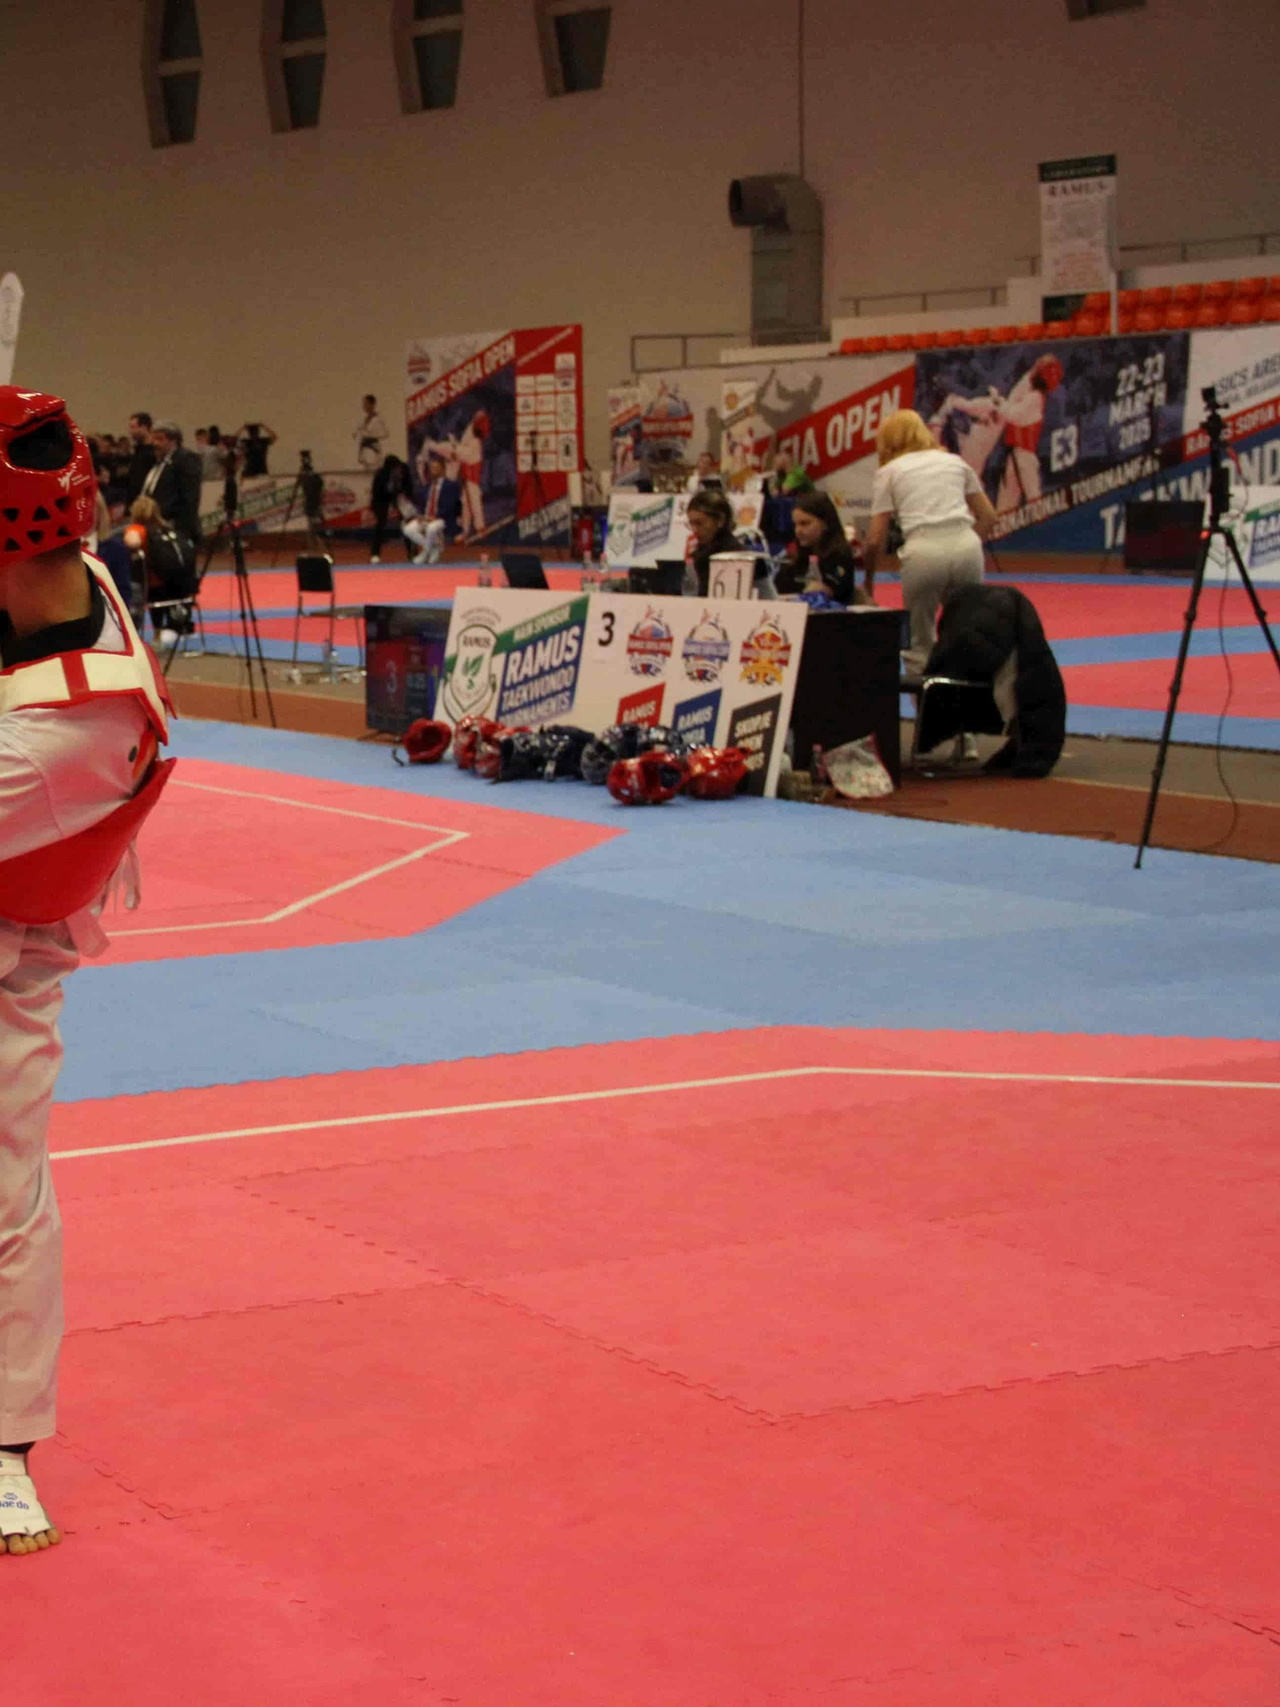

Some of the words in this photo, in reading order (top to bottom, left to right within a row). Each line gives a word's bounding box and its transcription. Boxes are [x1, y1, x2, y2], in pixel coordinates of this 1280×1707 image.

[826, 385, 902, 458] OPEN
[1051, 425, 1079, 473] E3
[505, 625, 580, 687] RAMUS
[598, 611, 616, 647] 3
